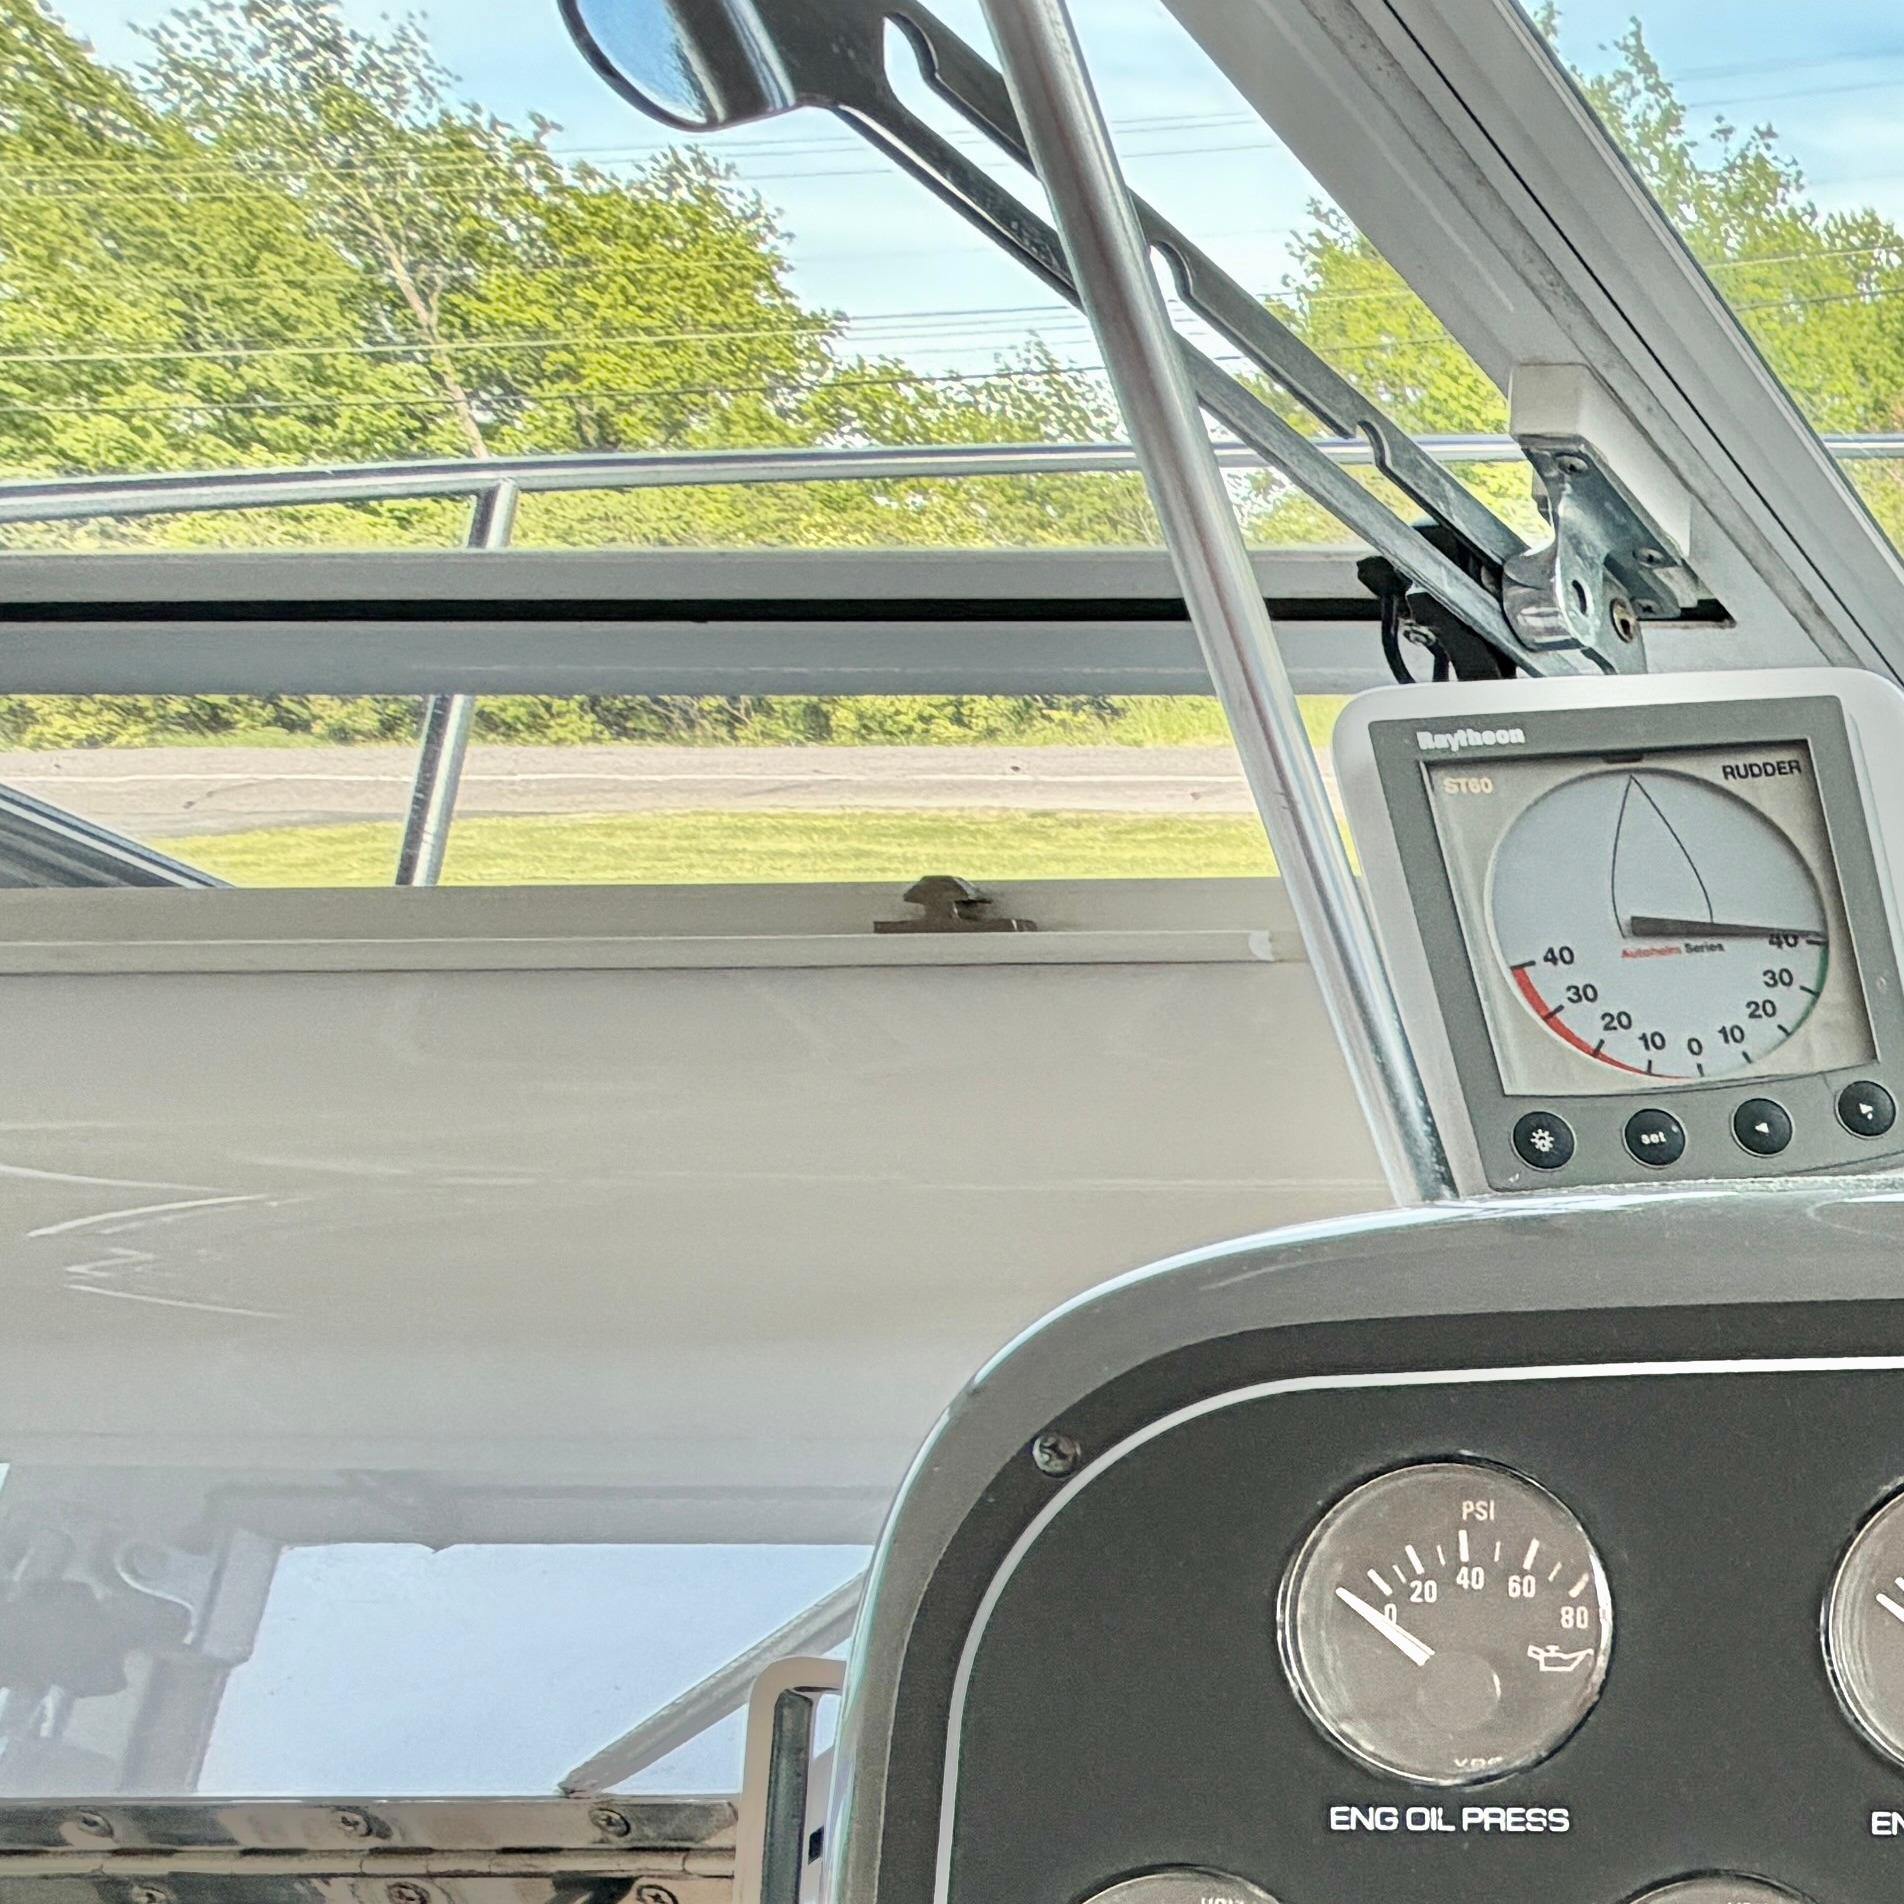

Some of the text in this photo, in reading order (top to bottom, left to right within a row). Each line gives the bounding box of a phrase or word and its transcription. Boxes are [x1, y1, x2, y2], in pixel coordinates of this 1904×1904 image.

[1416, 728, 1525, 752] Raytheon
[1721, 758, 1802, 781] RUDDER
[1443, 776, 1494, 794] ST60
[1543, 946, 1575, 966] 40
[1684, 942, 1725, 954] Series
[1763, 968, 1793, 988] 30
[1567, 983, 1598, 1004] 30
[1745, 1000, 1777, 1019] 20
[1600, 1012, 1633, 1032] 20
[1640, 1032, 1666, 1052] 10
[1718, 1025, 1746, 1046] 10
[1688, 1038, 1703, 1057] 0
[1641, 1131, 1667, 1145] set
[1462, 1500, 1495, 1521] PSI
[1456, 1566, 1485, 1590] 40
[1508, 1575, 1536, 1598] 60
[1410, 1580, 1437, 1603] 20
[1384, 1603, 1397, 1625] 0
[1560, 1606, 1589, 1629] 80
[1330, 1806, 1570, 1832] ENG OIL PRESS
